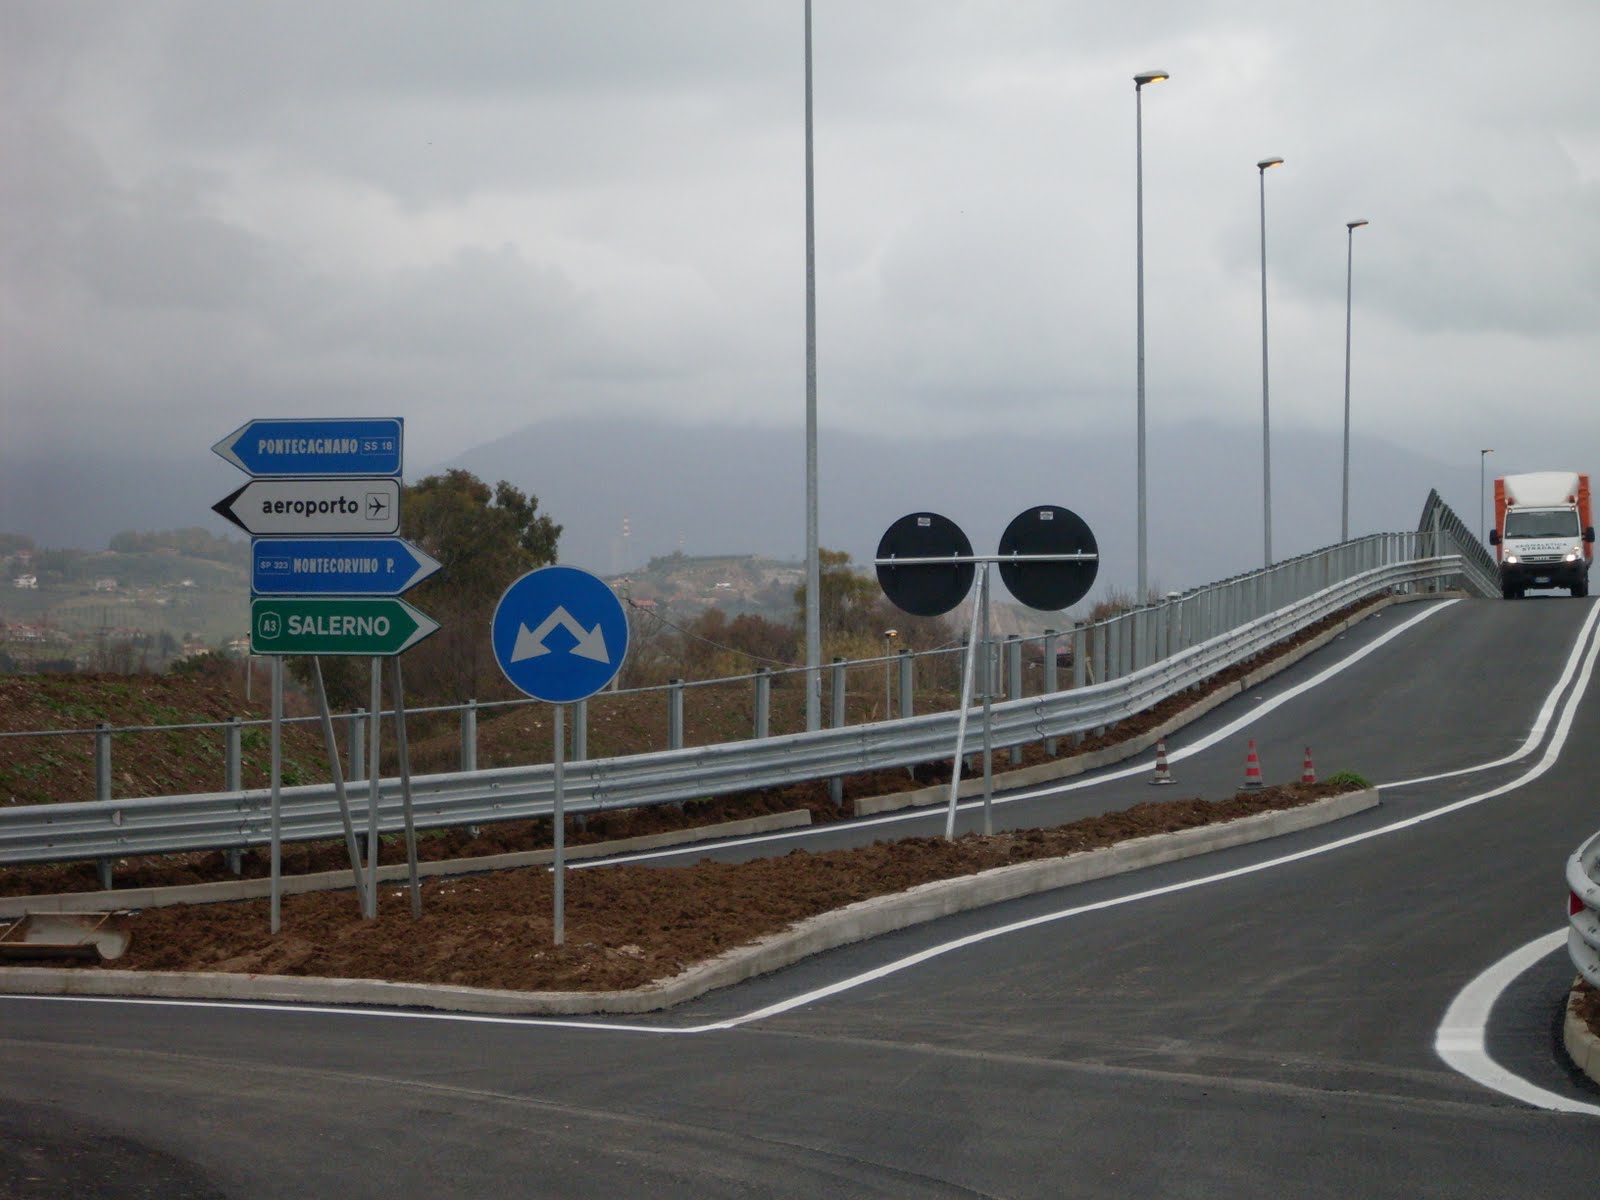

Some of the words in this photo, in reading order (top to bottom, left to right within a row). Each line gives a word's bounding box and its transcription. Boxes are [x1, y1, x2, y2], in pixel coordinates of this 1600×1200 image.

[258, 438, 358, 454] PONTECAGNANO
[363, 441, 378, 451] SS
[382, 441, 393, 451] 18
[262, 496, 359, 517] aeroporto
[260, 561, 271, 569] SP
[293, 558, 379, 573] MONTECORVINO
[386, 558, 395, 573] P.
[263, 619, 277, 632] A3
[287, 614, 390, 636] SALERNO
